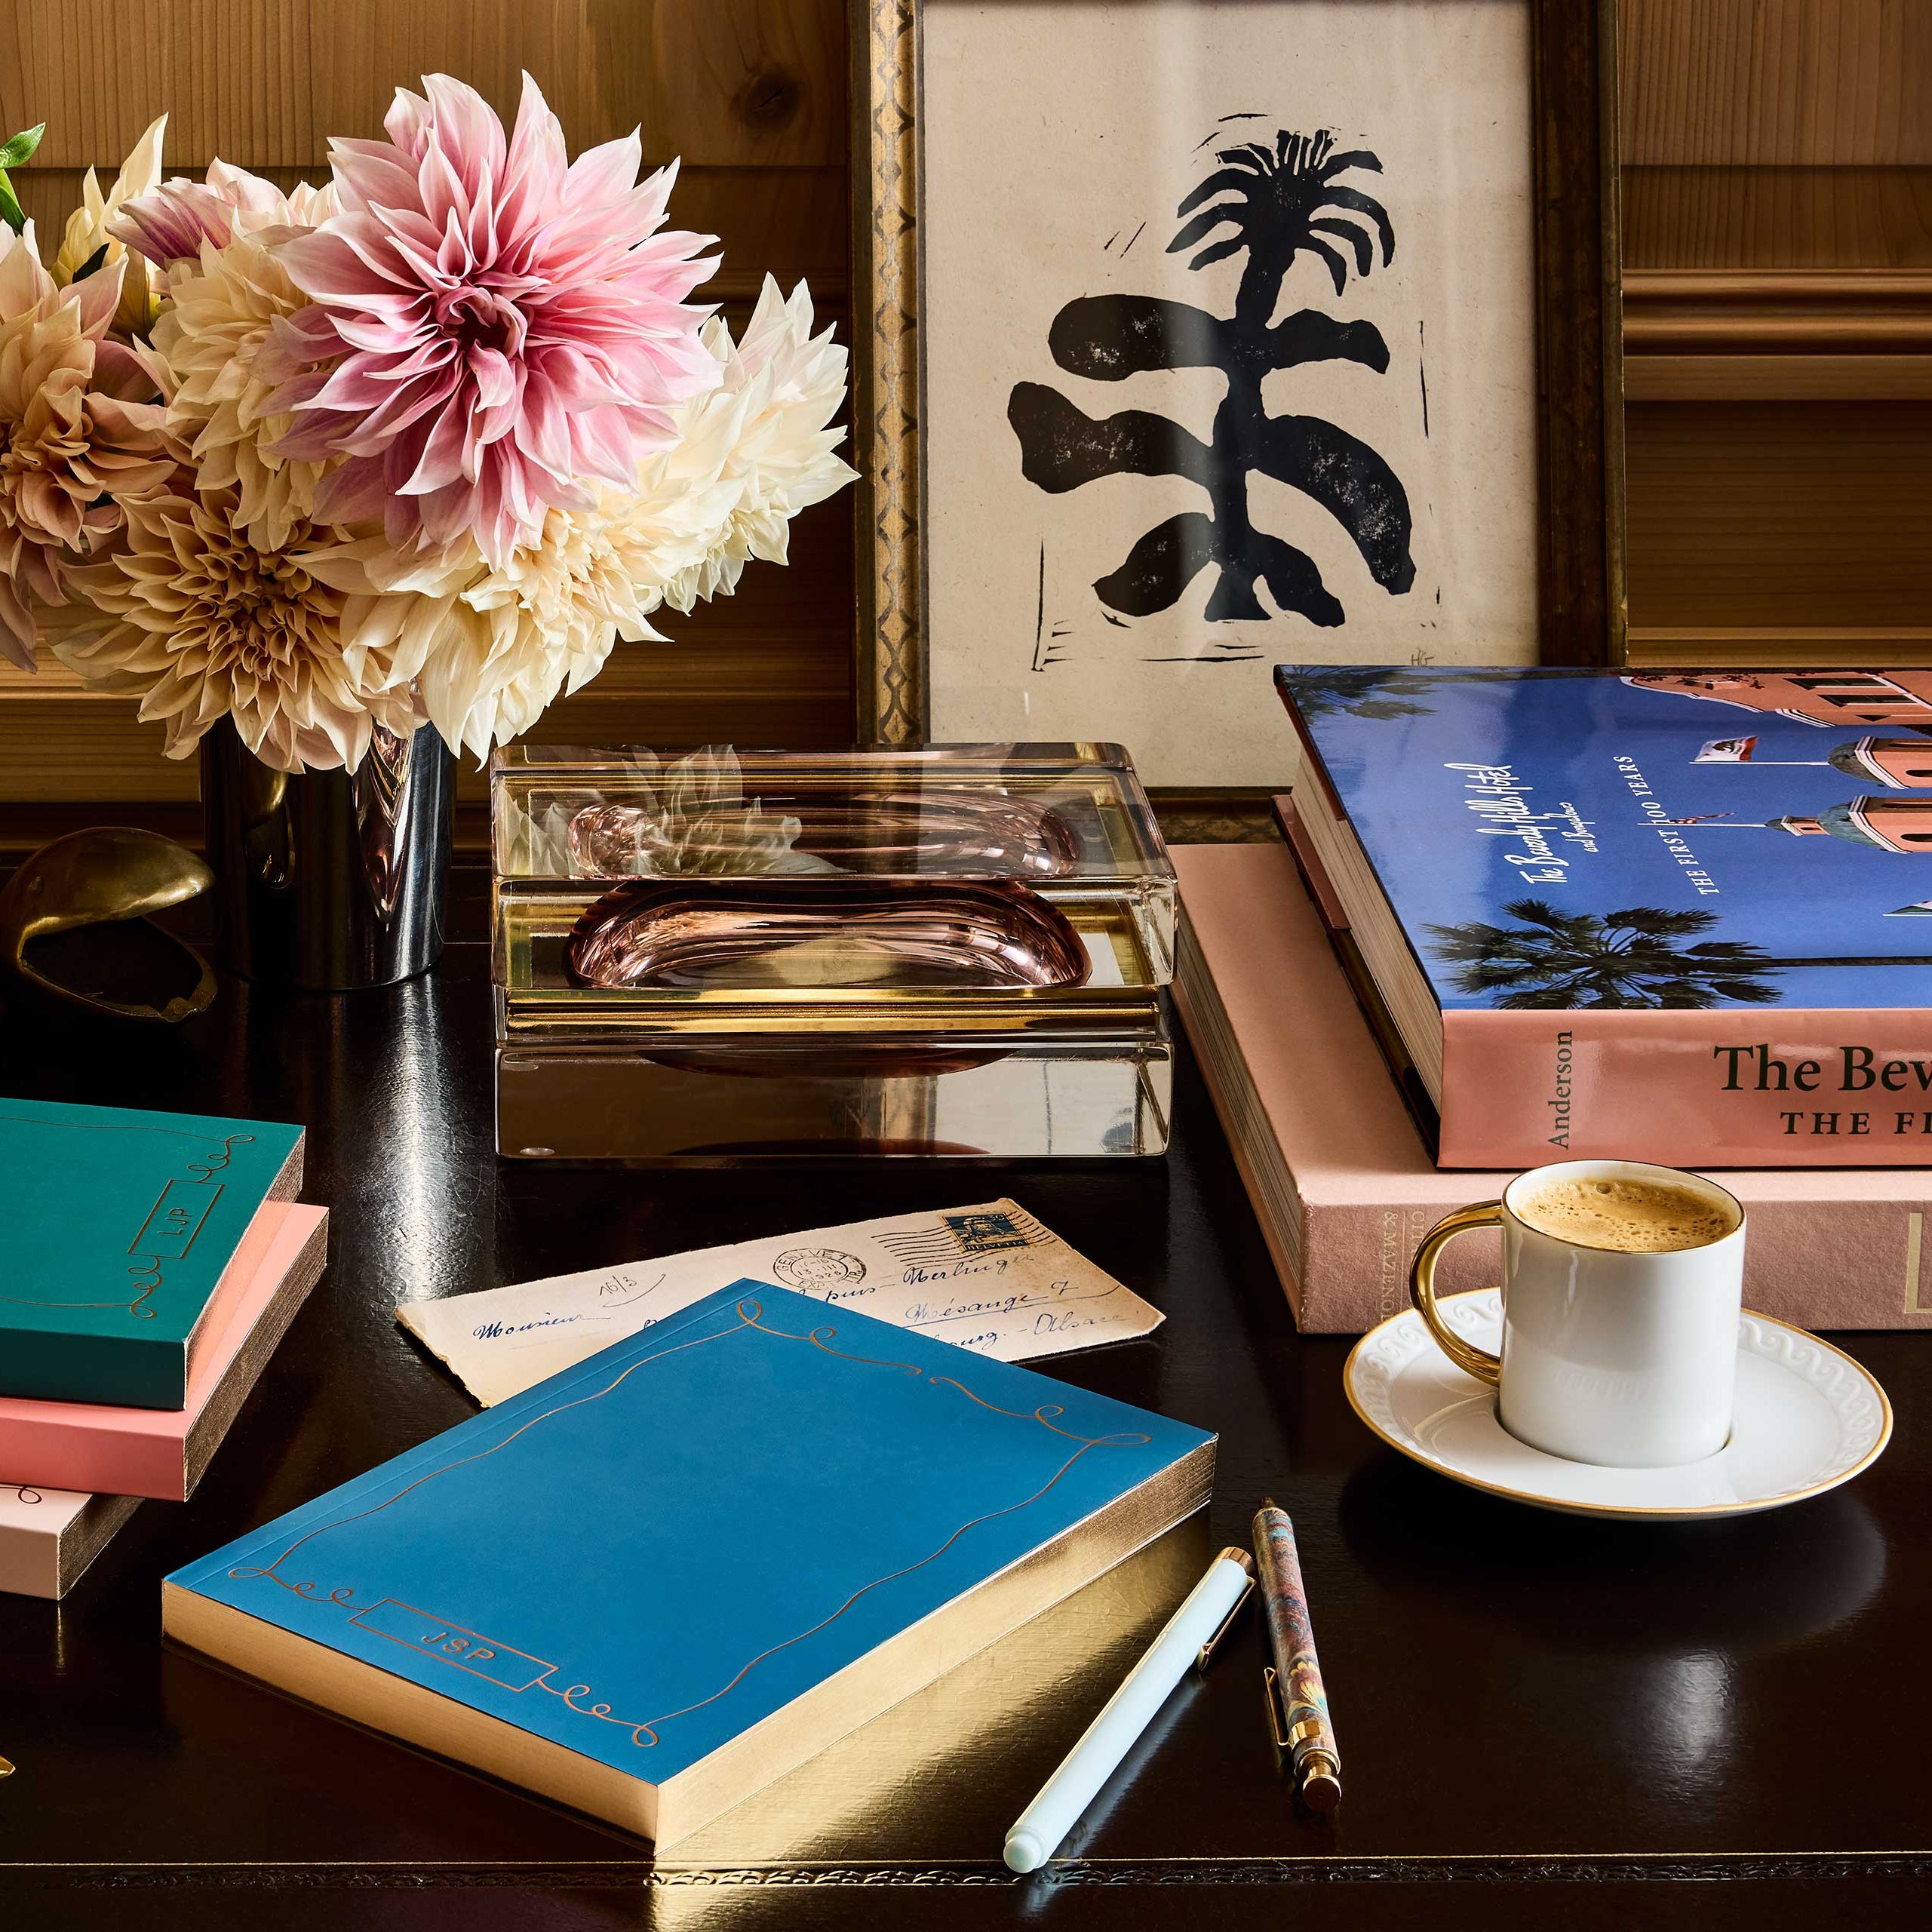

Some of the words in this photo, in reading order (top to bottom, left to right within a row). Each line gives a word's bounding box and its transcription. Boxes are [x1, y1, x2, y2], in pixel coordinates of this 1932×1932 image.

[1444, 763, 1533, 794] Hotel
[1613, 756, 1654, 797] YEARS
[1464, 796, 1550, 824] Hills
[1543, 802, 1596, 839] Bungalows
[1641, 801, 1672, 825] 100
[1476, 825, 1570, 867] Beverly
[1565, 838, 1599, 852] and
[1657, 829, 1700, 865] FIRST
[1519, 868, 1568, 884] The
[1685, 870, 1721, 895] THE
[1713, 1043, 1821, 1092] The
[1547, 1031, 1573, 1150] Anderson
[1780, 1111, 1871, 1135] THE
[157, 1207, 193, 1236] LJP
[967, 1240, 1024, 1250] HELVETIA
[472, 1312, 582, 1341] Monsieur
[422, 1632, 496, 1660] JSP
